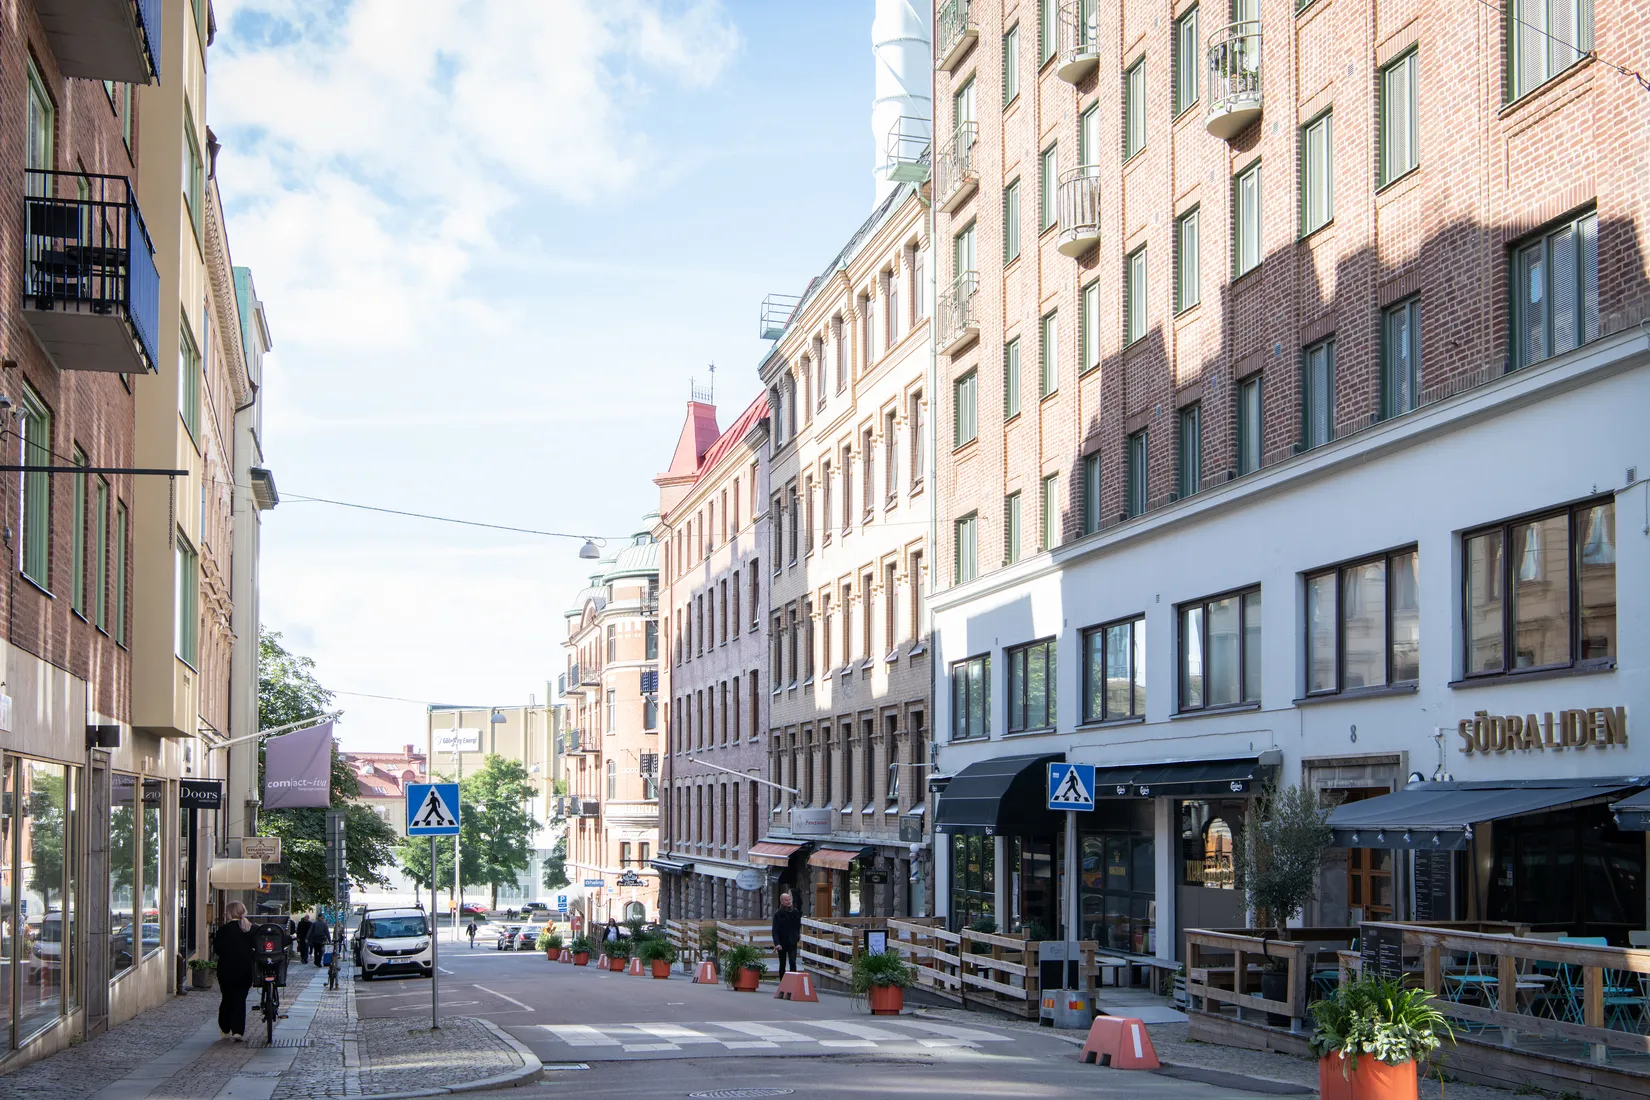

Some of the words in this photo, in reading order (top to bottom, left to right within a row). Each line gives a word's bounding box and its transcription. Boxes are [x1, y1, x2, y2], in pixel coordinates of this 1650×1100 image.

[1350, 724, 1357, 743] 8
[1544, 706, 1626, 748] LIDEN
[180, 786, 218, 799] Doors
